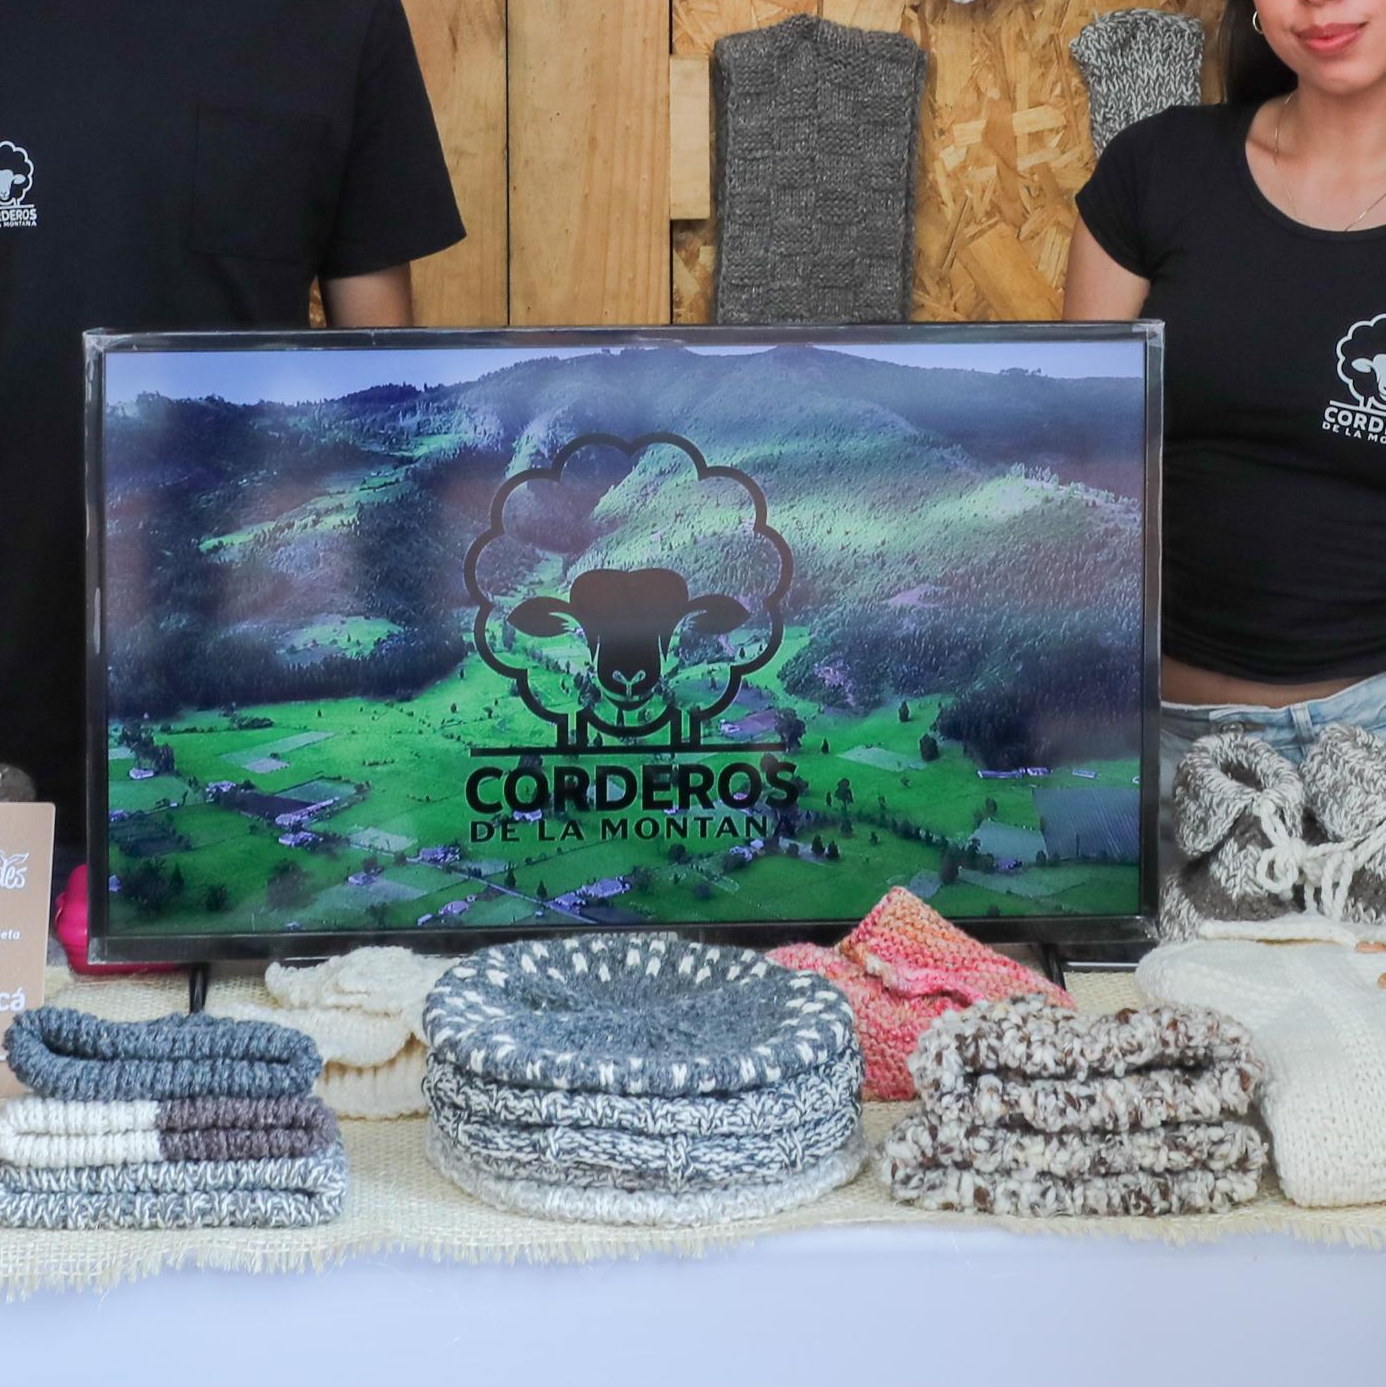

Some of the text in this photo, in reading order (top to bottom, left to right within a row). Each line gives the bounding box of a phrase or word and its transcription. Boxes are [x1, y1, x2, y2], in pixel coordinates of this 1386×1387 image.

[1322, 421, 1340, 433] DE
[1345, 427, 1362, 439] LA
[465, 761, 799, 814] CORDEROS
[470, 819, 518, 842] DE
[537, 818, 585, 842] LA
